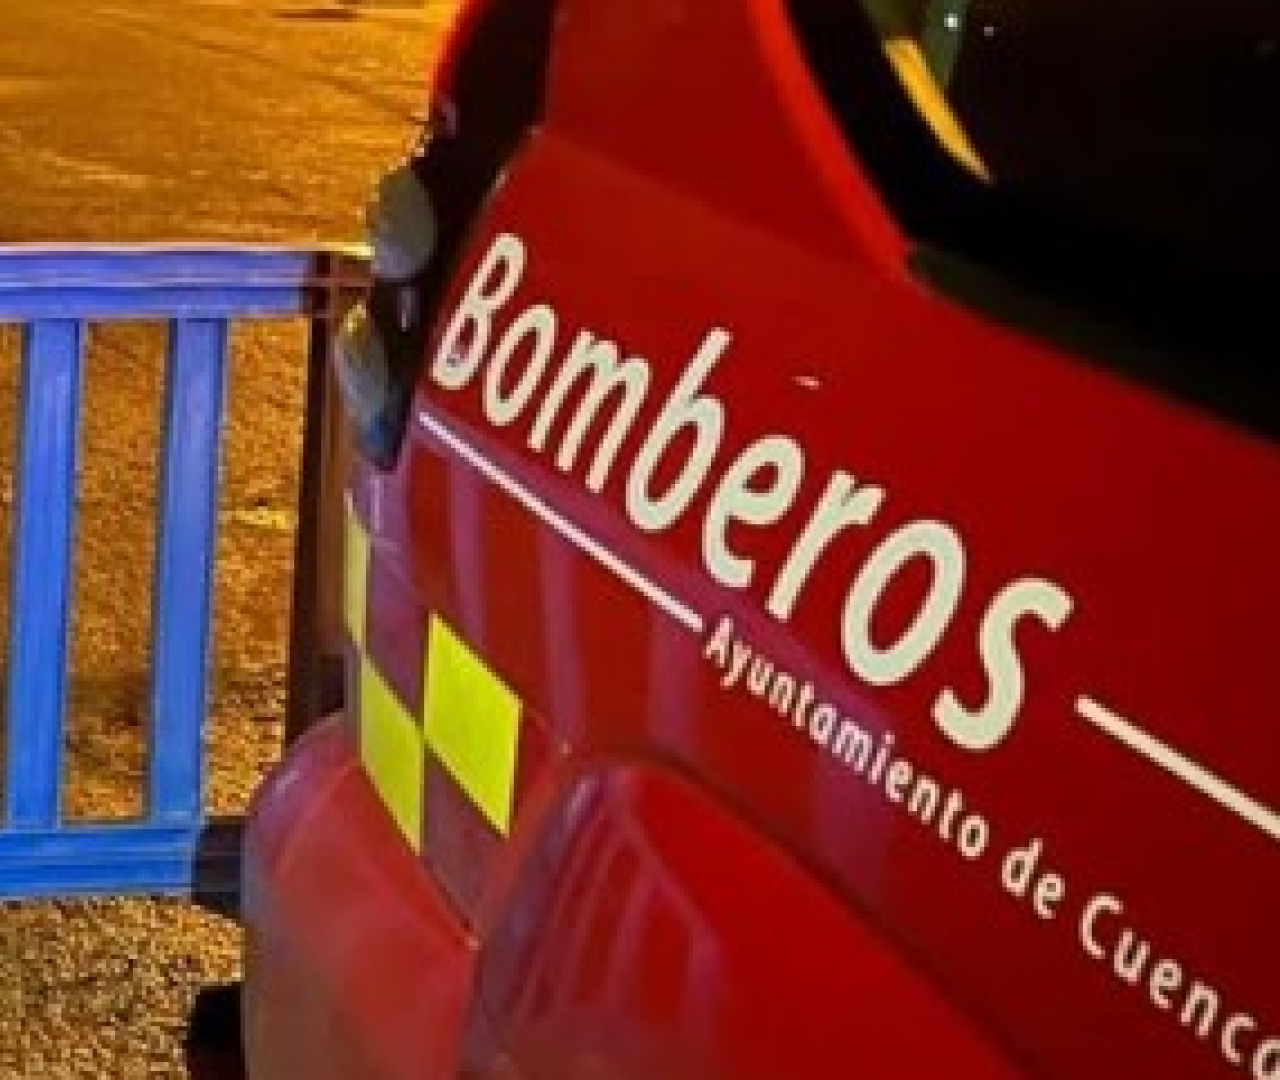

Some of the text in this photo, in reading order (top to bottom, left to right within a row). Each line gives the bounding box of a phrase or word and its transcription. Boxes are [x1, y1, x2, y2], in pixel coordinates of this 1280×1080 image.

[429, 231, 1075, 751] Bomberos
[703, 616, 990, 858] Ayuntamiento
[999, 839, 1066, 920] de
